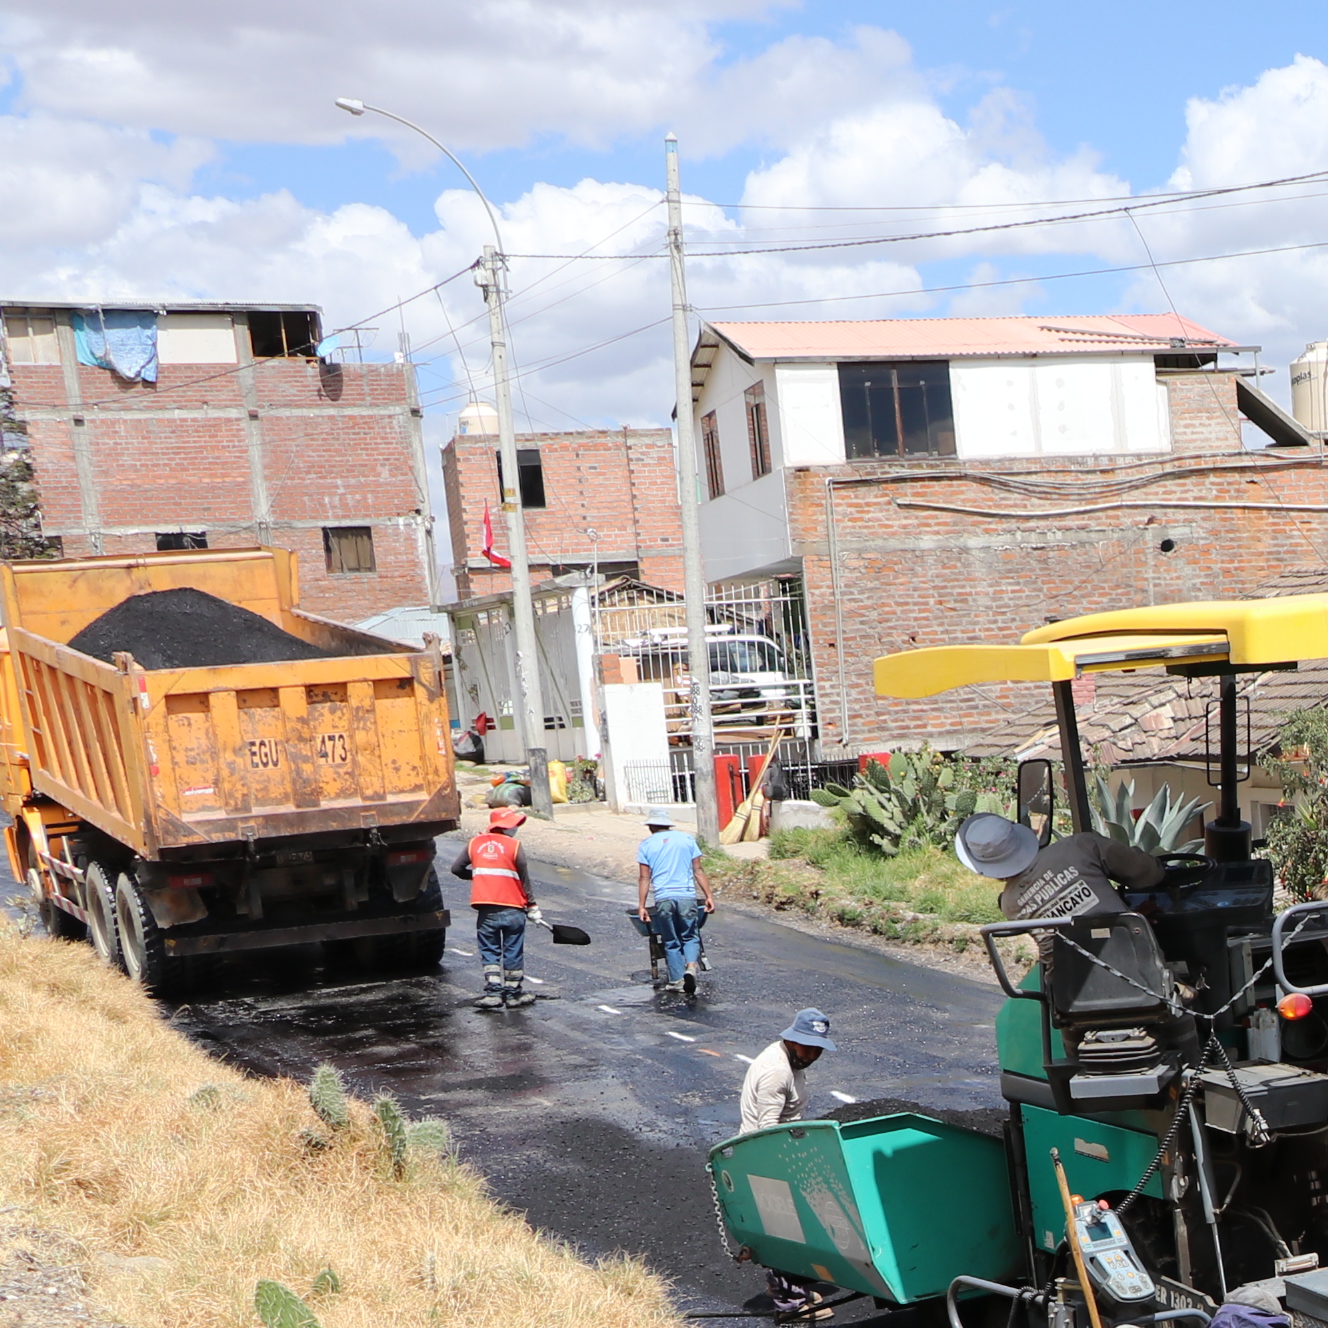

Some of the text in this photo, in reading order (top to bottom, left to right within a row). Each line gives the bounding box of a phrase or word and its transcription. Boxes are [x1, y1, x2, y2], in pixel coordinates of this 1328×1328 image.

[248, 733, 348, 768] EGU 473
[1017, 869, 1054, 906] GERENCIA DE
[1033, 866, 1079, 905] PUBLICAS
